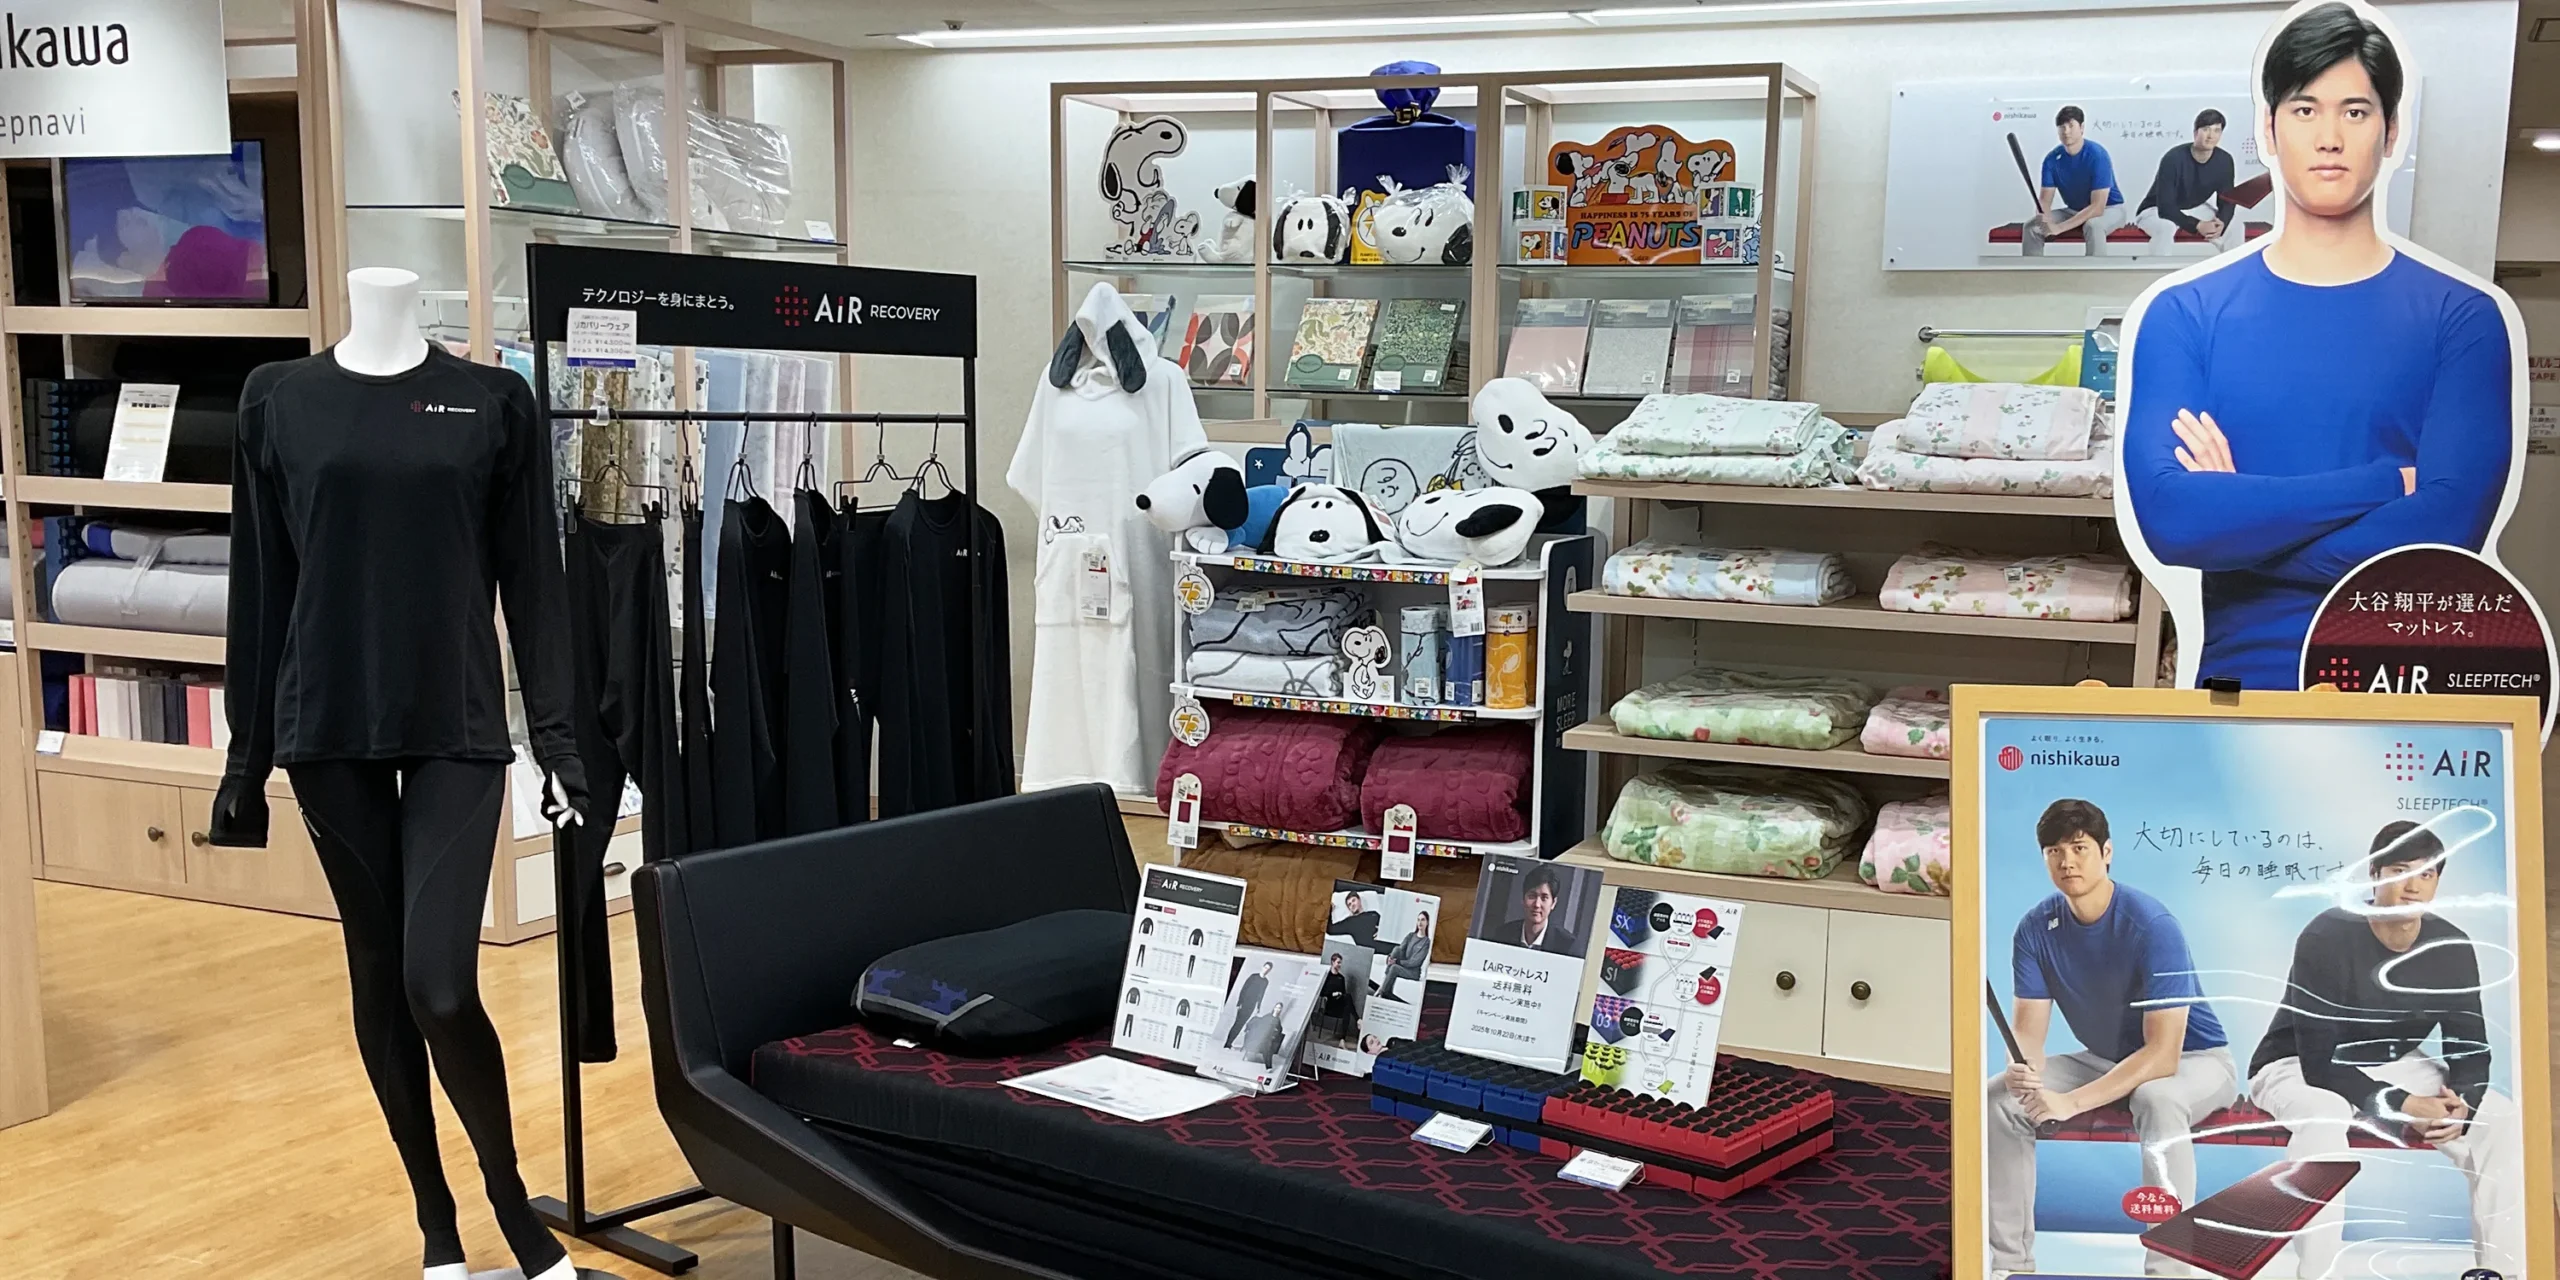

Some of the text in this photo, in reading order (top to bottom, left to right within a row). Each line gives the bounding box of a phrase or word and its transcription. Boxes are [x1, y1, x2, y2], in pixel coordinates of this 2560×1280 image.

[1580, 211, 1628, 219] HAPPINESS
[1571, 221, 1700, 249] PEANUTS
[582, 287, 735, 312] テクノロジーを身にまとう。
[870, 304, 941, 321] RECOVERY
[2348, 591, 2513, 613] 大谷翔平が選んだ
[2387, 618, 2475, 638] マットレス。
[2030, 749, 2120, 767] nishikawa
[1614, 914, 1632, 930] SX
[1492, 980, 1533, 996] 送料無料
[1596, 1012, 1612, 1029] 03
[2137, 1192, 2166, 1203] 今なら
[2130, 1203, 2175, 1215] 送料無料
